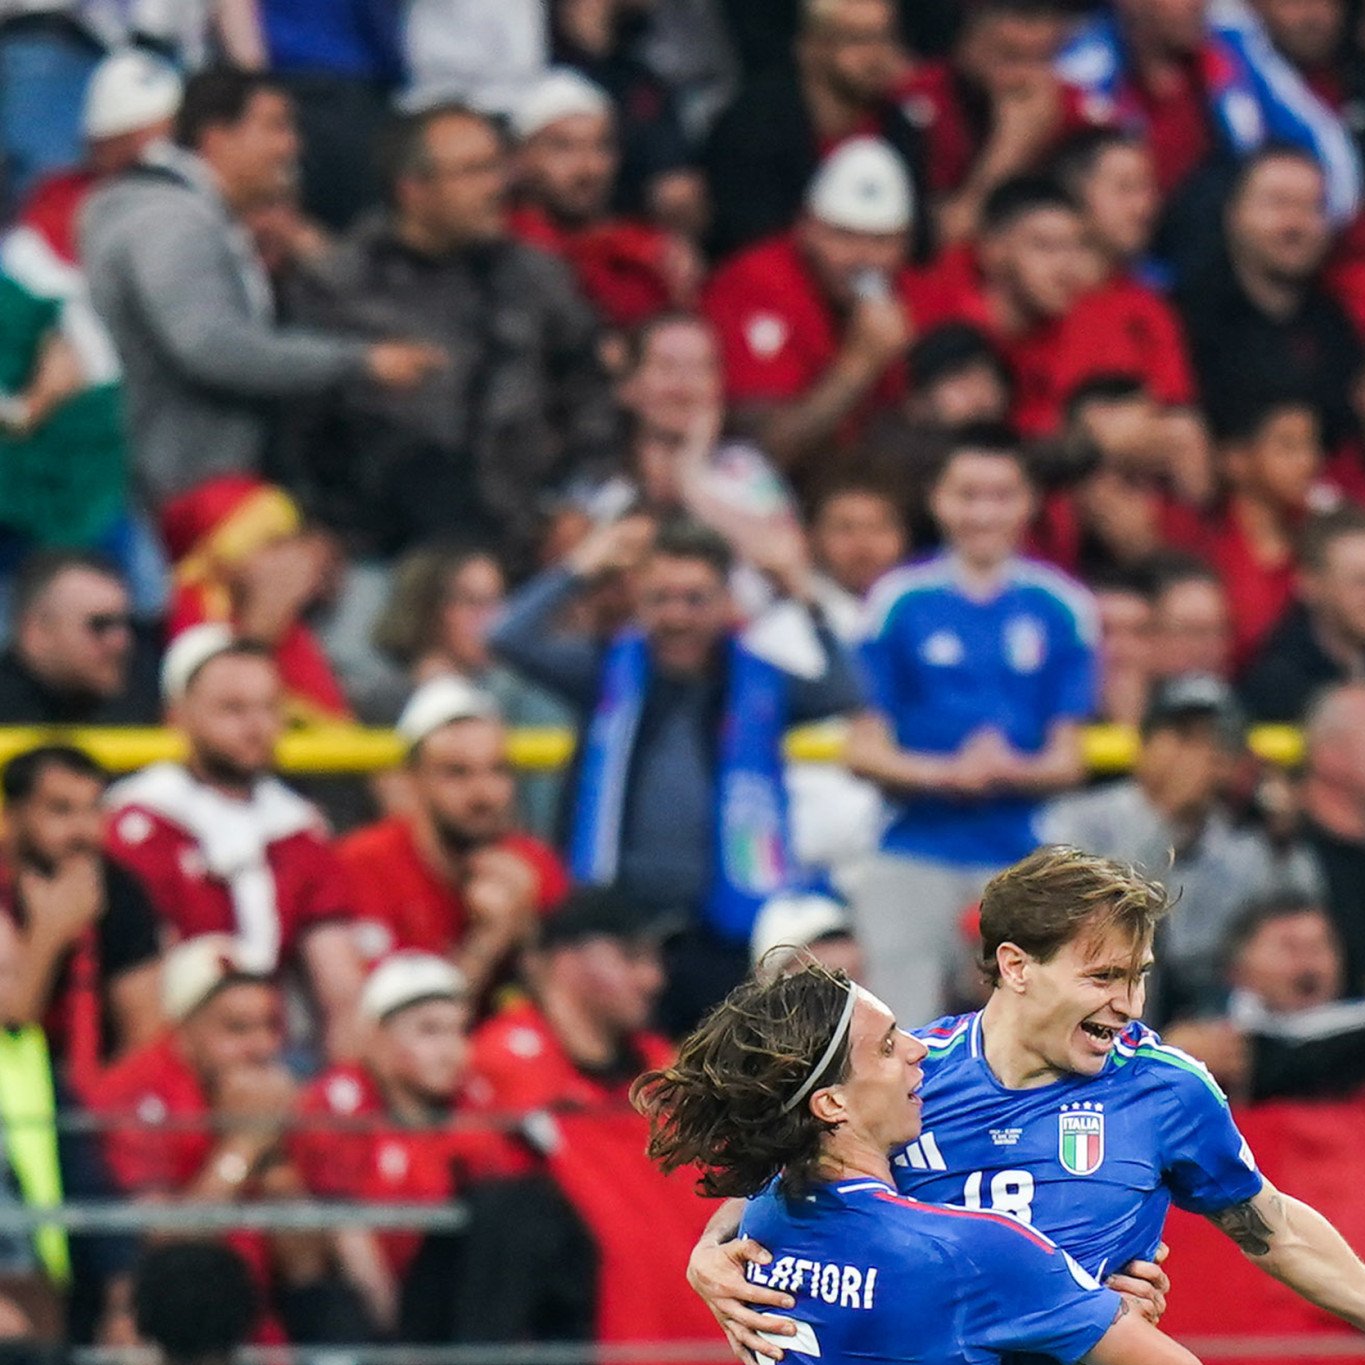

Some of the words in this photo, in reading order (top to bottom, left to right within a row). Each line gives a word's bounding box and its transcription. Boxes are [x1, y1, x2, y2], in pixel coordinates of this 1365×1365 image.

[1062, 1117, 1100, 1130] ITALIA
[963, 1169, 1035, 1225] 18
[745, 1250, 878, 1310] LAFIORI
